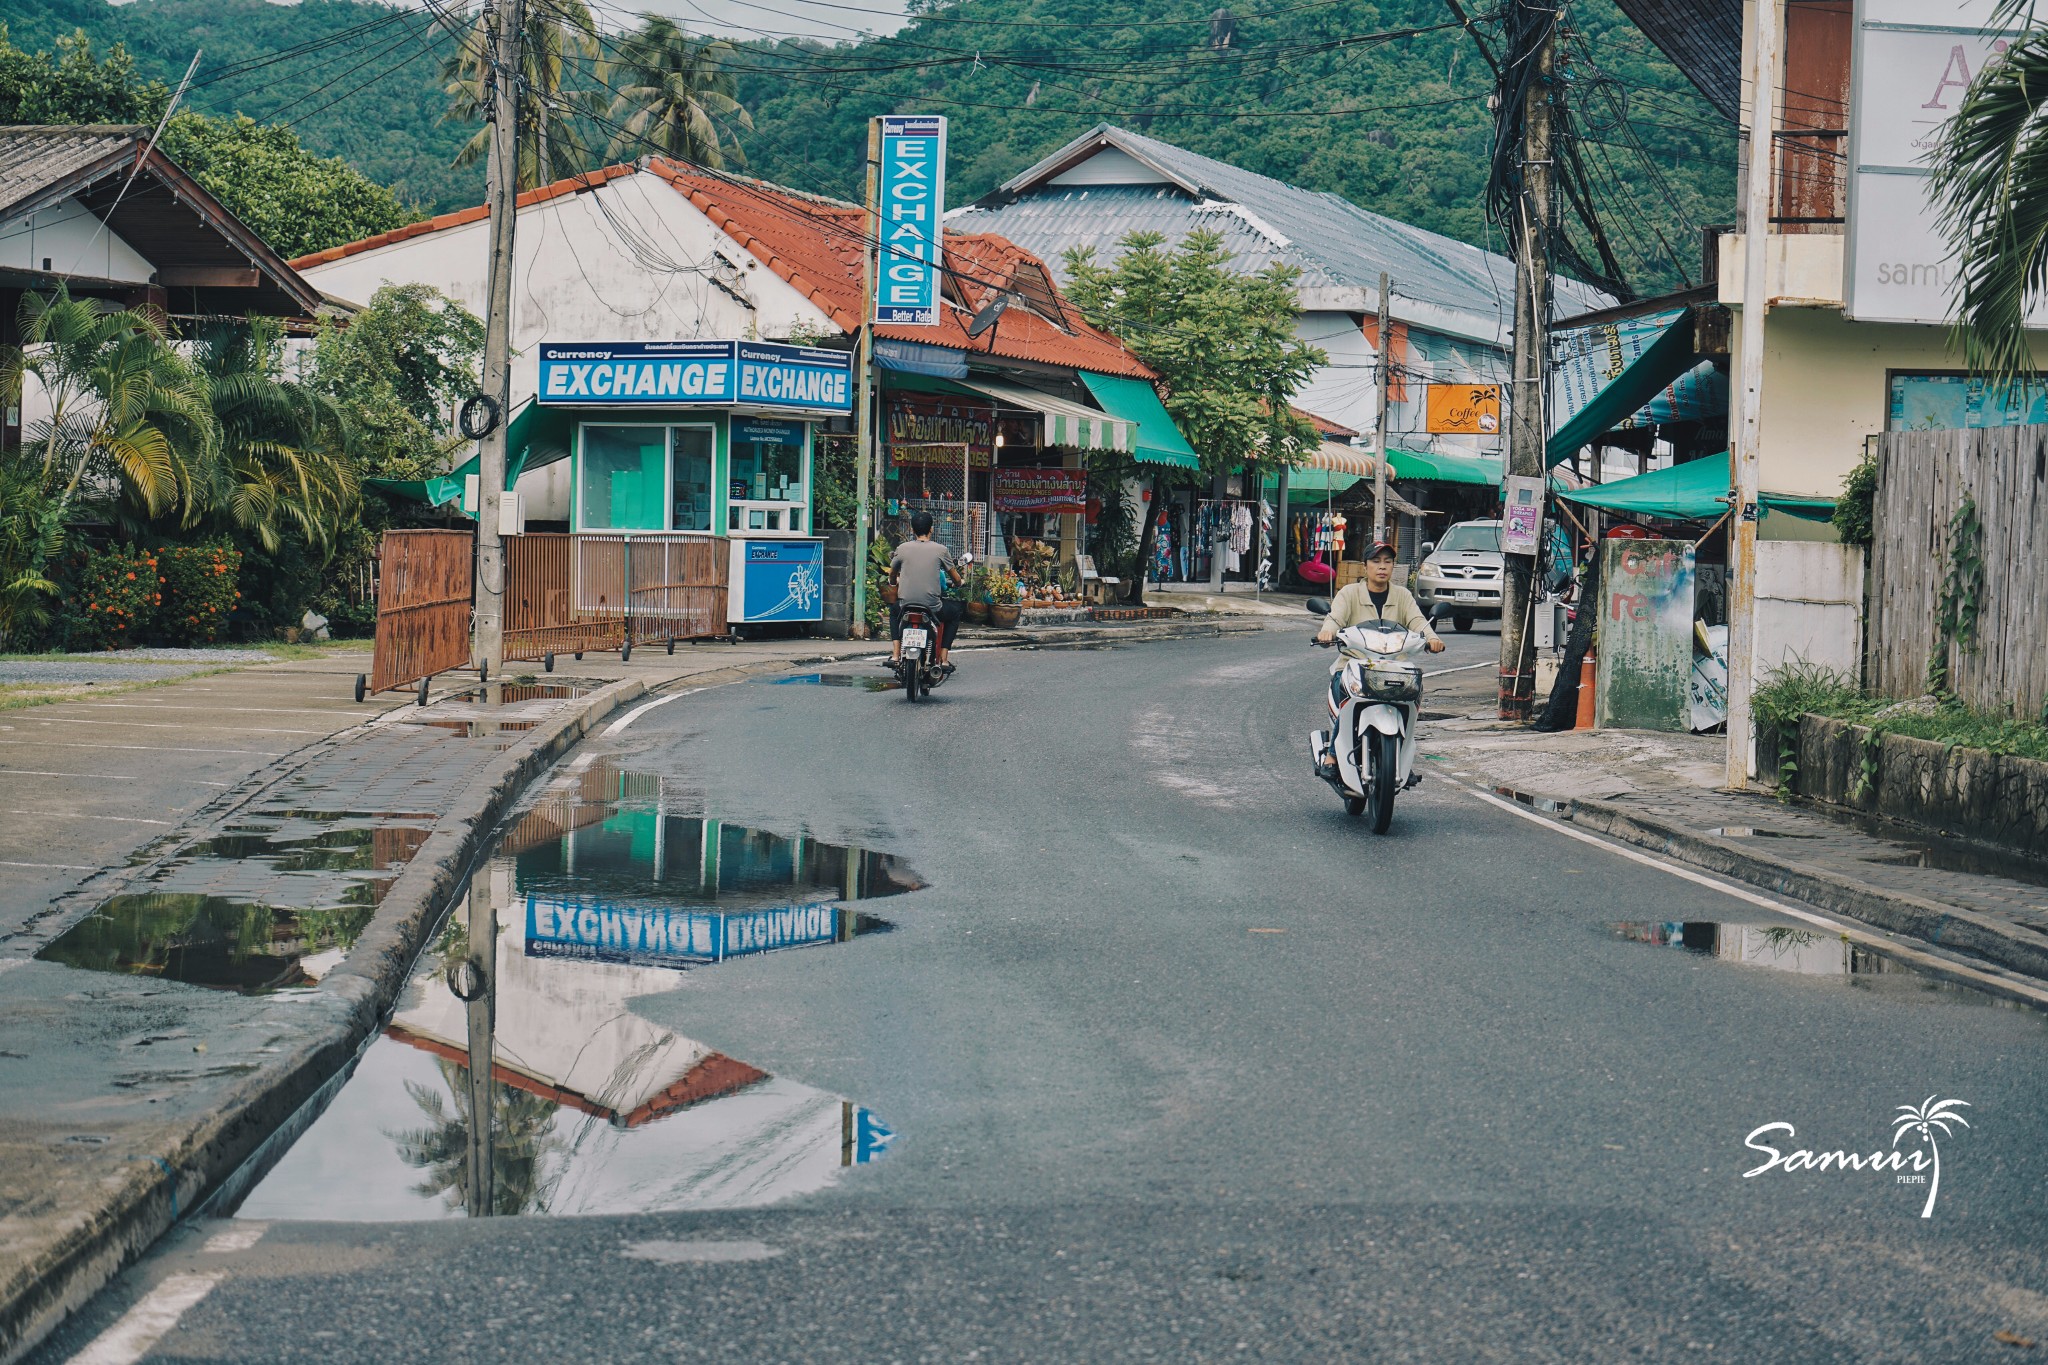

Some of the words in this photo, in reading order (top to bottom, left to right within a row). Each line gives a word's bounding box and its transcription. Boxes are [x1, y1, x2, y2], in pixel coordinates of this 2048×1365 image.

[889, 140, 928, 303] EXCHANGE
[892, 309, 913, 322] Better
[915, 310, 932, 323] Rate
[547, 350, 612, 360] Currency
[741, 348, 781, 363] Currency
[546, 363, 728, 396] EXCHANGE
[740, 364, 847, 404] EXCHANGE
[1449, 407, 1480, 419] Coffee
